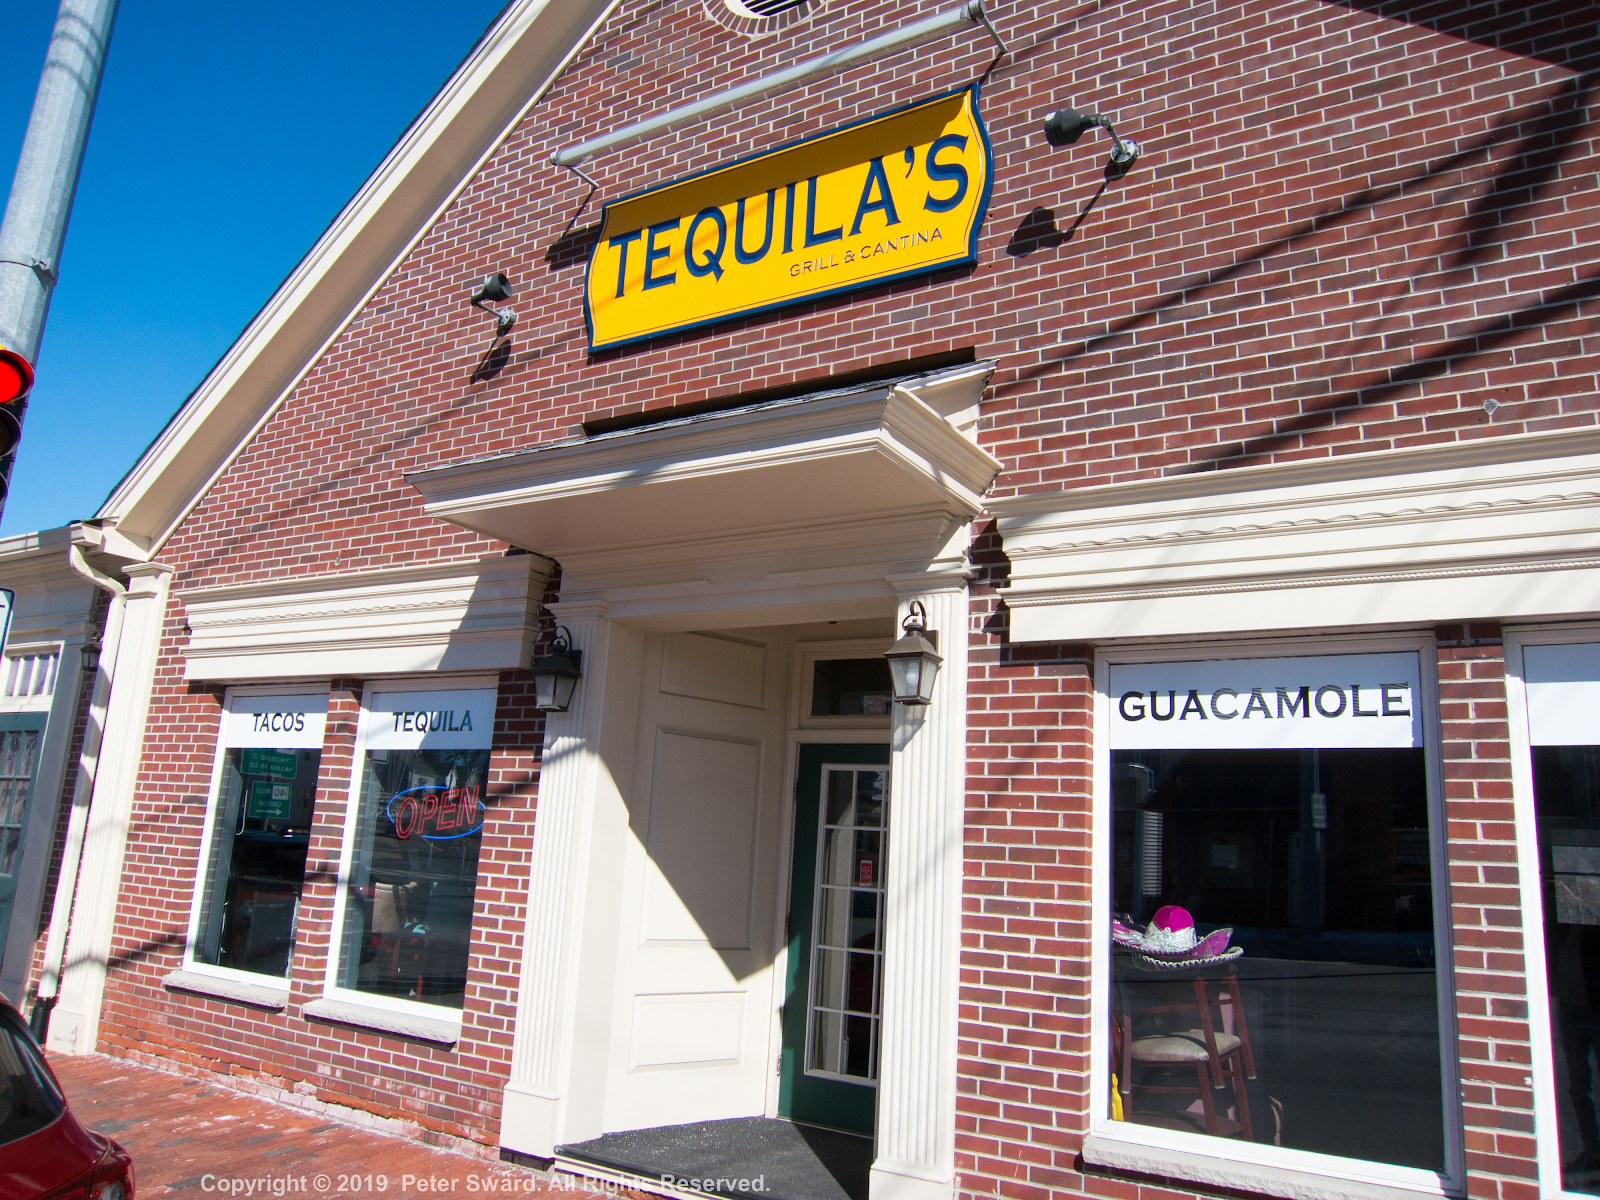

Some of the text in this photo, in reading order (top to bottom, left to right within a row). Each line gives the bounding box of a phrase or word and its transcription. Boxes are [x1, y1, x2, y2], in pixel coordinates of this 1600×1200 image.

[608, 134, 970, 299] TEQUILA'S
[789, 227, 943, 277] GRILL & CANTINA
[252, 712, 305, 732] TACOS
[392, 709, 473, 732] TEQUILA
[1118, 681, 1411, 722] GUACAMOLE
[394, 784, 480, 840] OPEN
